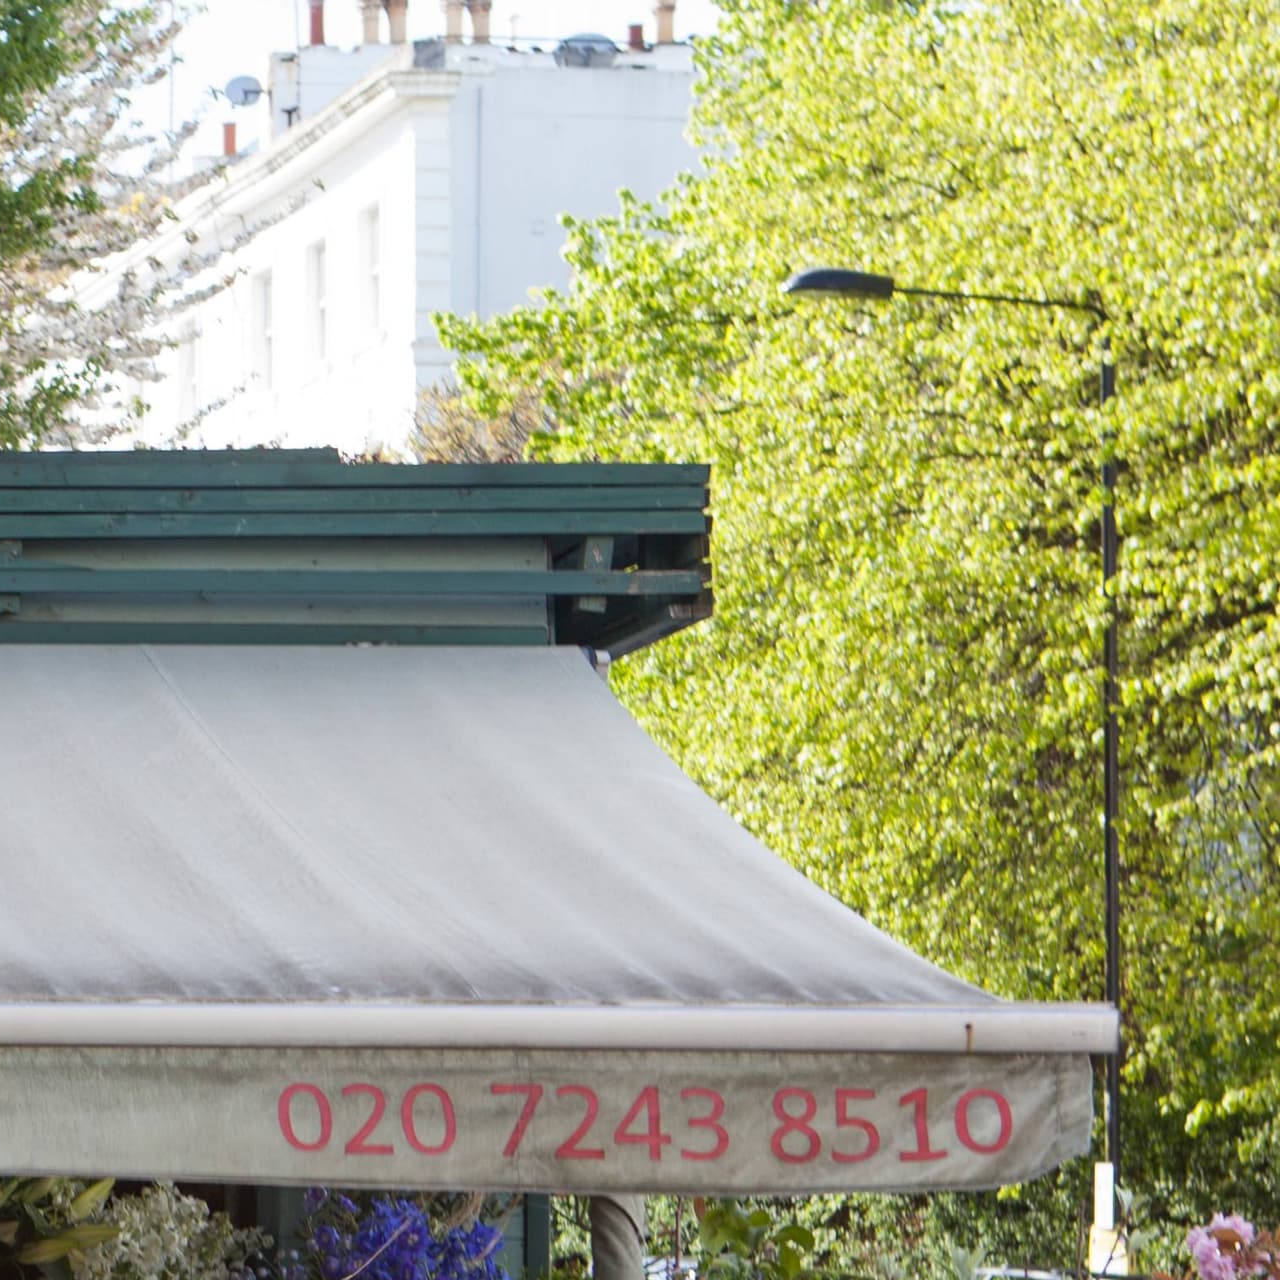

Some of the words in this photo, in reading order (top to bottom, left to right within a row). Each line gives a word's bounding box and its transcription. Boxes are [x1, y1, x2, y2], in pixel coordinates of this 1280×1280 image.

[277, 1082, 457, 1156] 020
[490, 1084, 731, 1162] 7243
[771, 1087, 1014, 1165] 8510
